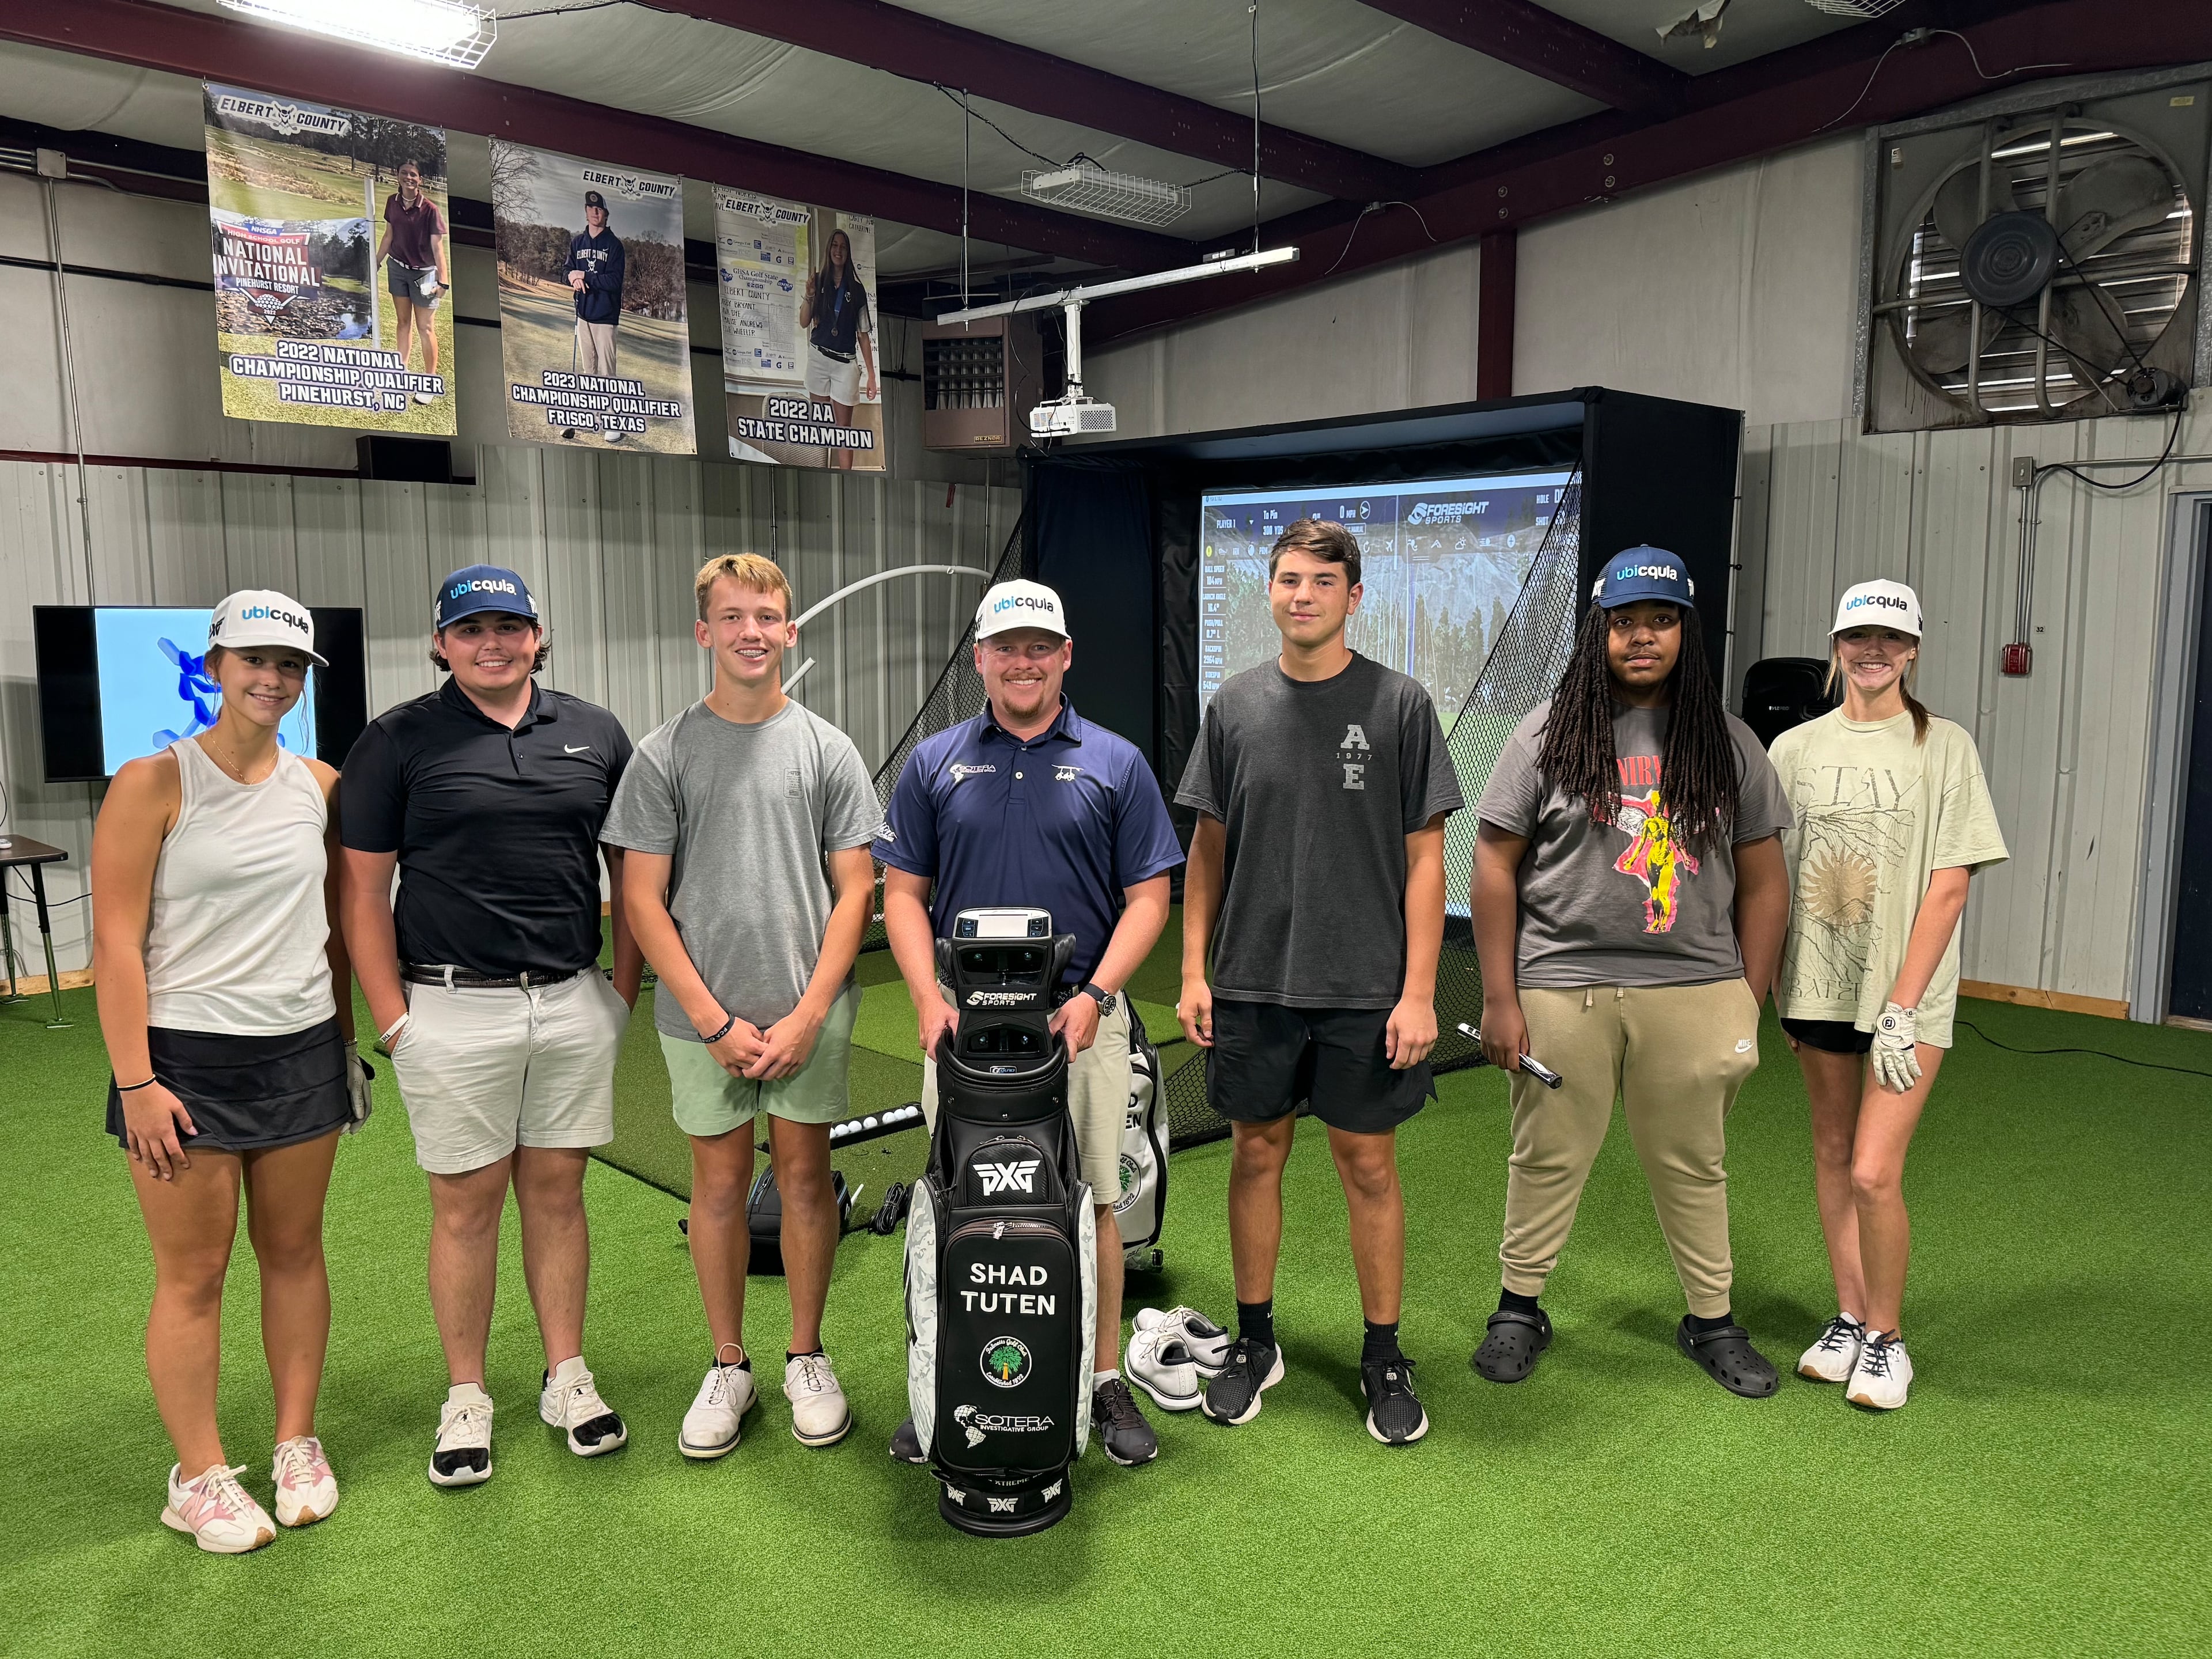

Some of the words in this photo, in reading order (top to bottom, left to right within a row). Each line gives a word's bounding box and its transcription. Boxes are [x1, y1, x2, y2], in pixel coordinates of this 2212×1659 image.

[220, 99, 274, 118] ELBERT
[296, 112, 347, 132] COUNTY
[583, 171, 621, 187] ELBERT
[639, 181, 675, 196] COUNTY
[726, 199, 760, 214] ELBERT
[776, 209, 808, 224] COUNTY
[228, 229, 247, 238] HIGH
[248, 234, 278, 243] SCHOOL
[251, 226, 277, 234] NHSGA
[223, 237, 306, 265] NATIONAL
[213, 253, 320, 287] INVITATIONAL
[739, 275, 772, 285] Championship
[236, 278, 272, 290] PINEHURST
[274, 283, 299, 294] RESORT
[748, 290, 770, 300] COUNTY
[278, 342, 319, 362] 2022
[323, 349, 403, 370] NATIONAL
[233, 358, 360, 386] CHAMPIONSHIP
[364, 372, 444, 393] QUALIFIER
[544, 372, 575, 388] 2023
[579, 376, 645, 396] NATIONAL
[279, 384, 380, 411] PINEHURST,
[382, 394, 406, 410] NC
[512, 386, 609, 410] CHAMPIONSHIP
[612, 399, 680, 417] QUALIFIER
[548, 409, 599, 430] FRISCO,
[601, 415, 645, 431] TEXAS
[770, 399, 808, 419] 2022
[813, 404, 834, 422] AA
[738, 418, 784, 441] STATE
[789, 425, 873, 448] CHAMPION
[1536, 494, 1550, 503] HOLE
[1217, 520, 1232, 528] PLAYER
[1233, 520, 1236, 528] 1
[1263, 510, 1268, 520] To
[1425, 515, 1461, 524] SPORTS
[1536, 516, 1549, 526] SHOT
[1616, 565, 1677, 581] ubicqula
[450, 579, 517, 600] ubicqula
[994, 596, 1054, 613] ubicqula
[1846, 595, 1907, 611] ubicqula
[242, 606, 309, 635] ubicqula
[1340, 725, 1370, 750] A
[1343, 763, 1365, 790] E
[984, 993, 1037, 1001] FORESIGHT
[973, 1160, 1040, 1196] PXG
[970, 1263, 1047, 1286] SHAD
[960, 1291, 1055, 1315] TUTEN
[1006, 1339, 1018, 1347] Golf
[1012, 1374, 1024, 1383] 1892
[975, 1414, 1055, 1427] SOTERA
[946, 1482, 967, 1506] PXG
[1041, 1478, 1063, 1503] PXG
[987, 1498, 1018, 1513] PXG
